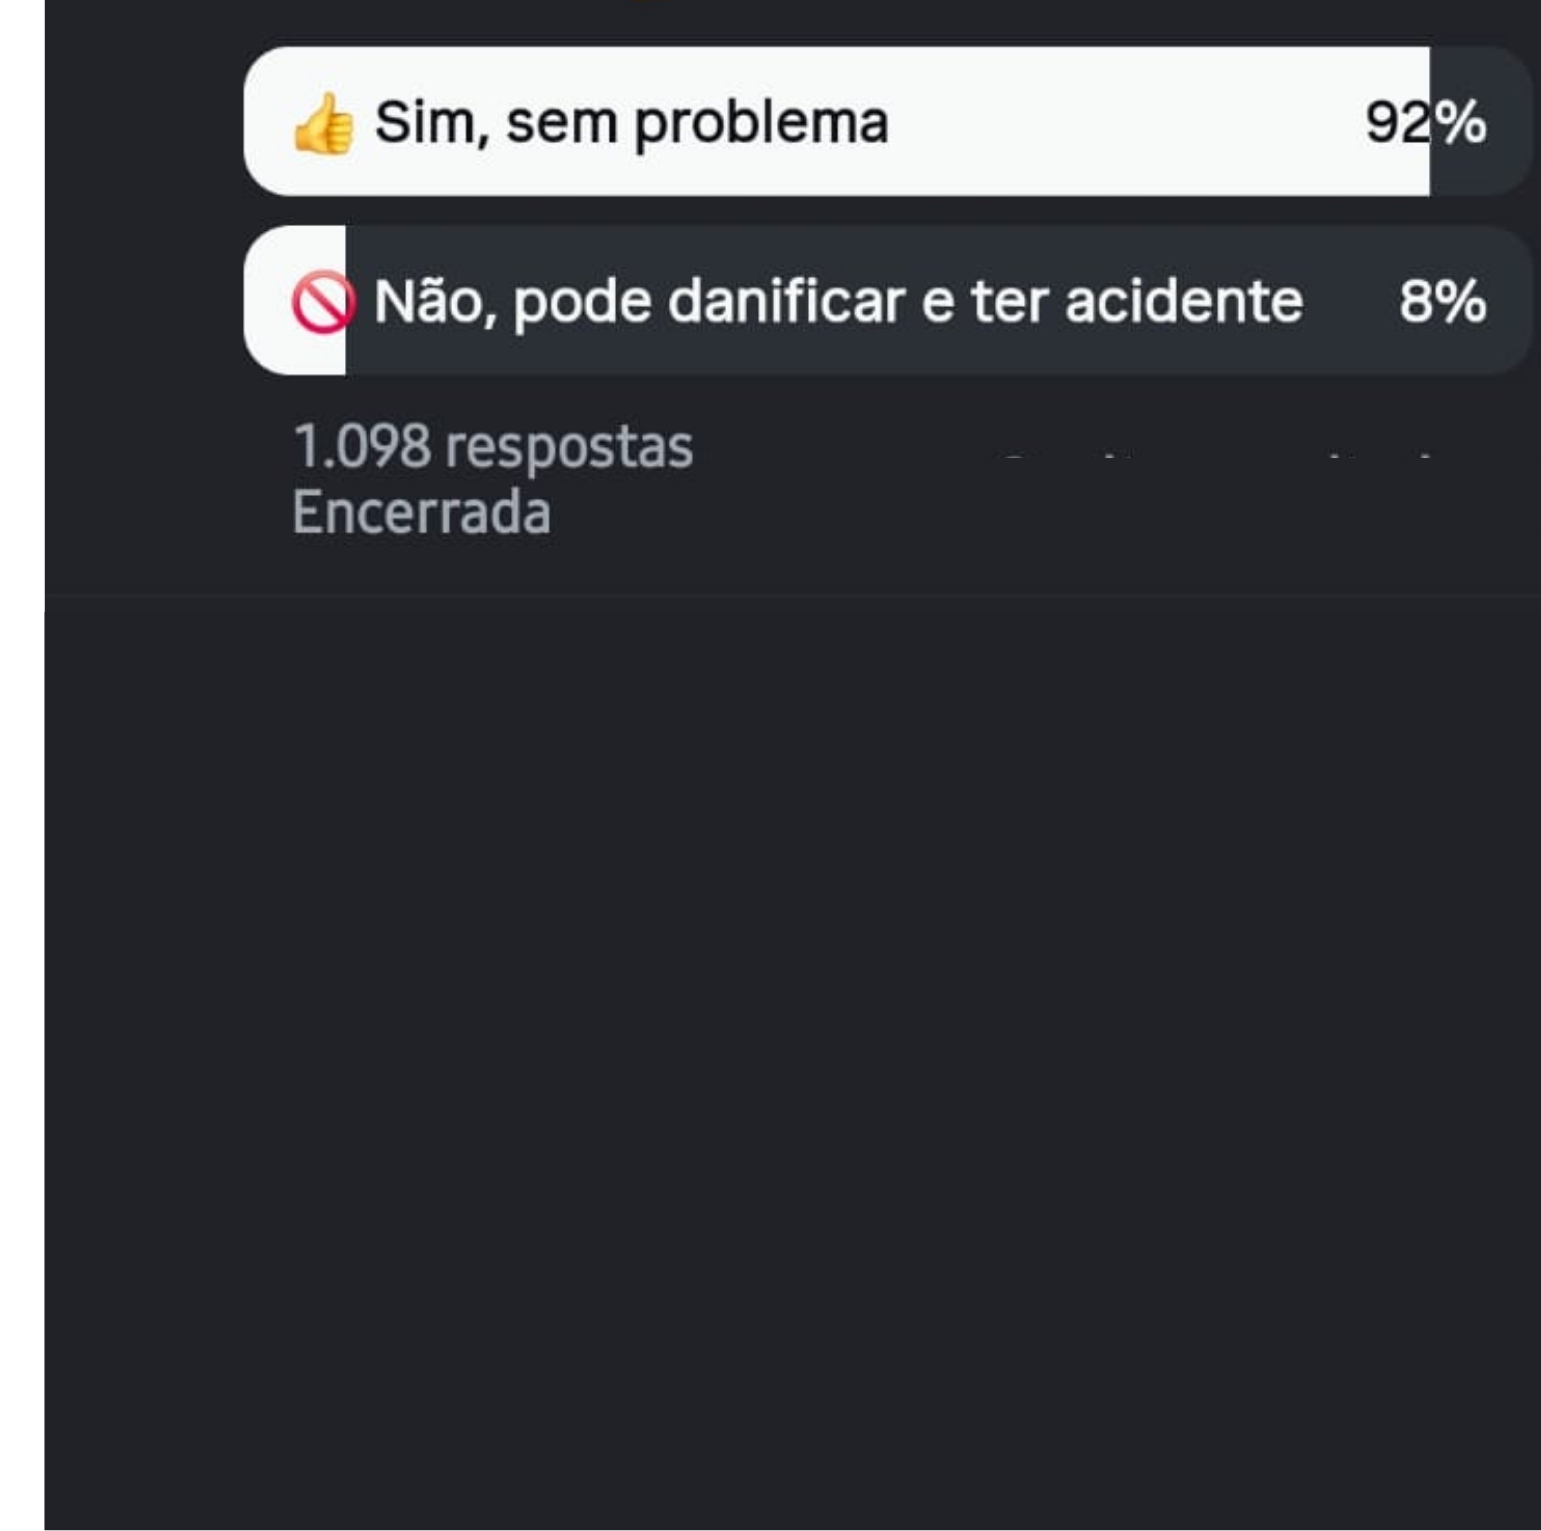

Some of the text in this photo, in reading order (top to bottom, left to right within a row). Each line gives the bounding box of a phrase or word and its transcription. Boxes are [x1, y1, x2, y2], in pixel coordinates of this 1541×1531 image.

[375, 97, 888, 157] Sim, sem problema
[1366, 97, 1487, 146] 92%
[375, 275, 1304, 337] Não, pode danificar e ter acidente
[1400, 276, 1487, 325] 8%
[294, 421, 694, 481] 1.098 respostas
[294, 485, 551, 535] Encerrada
